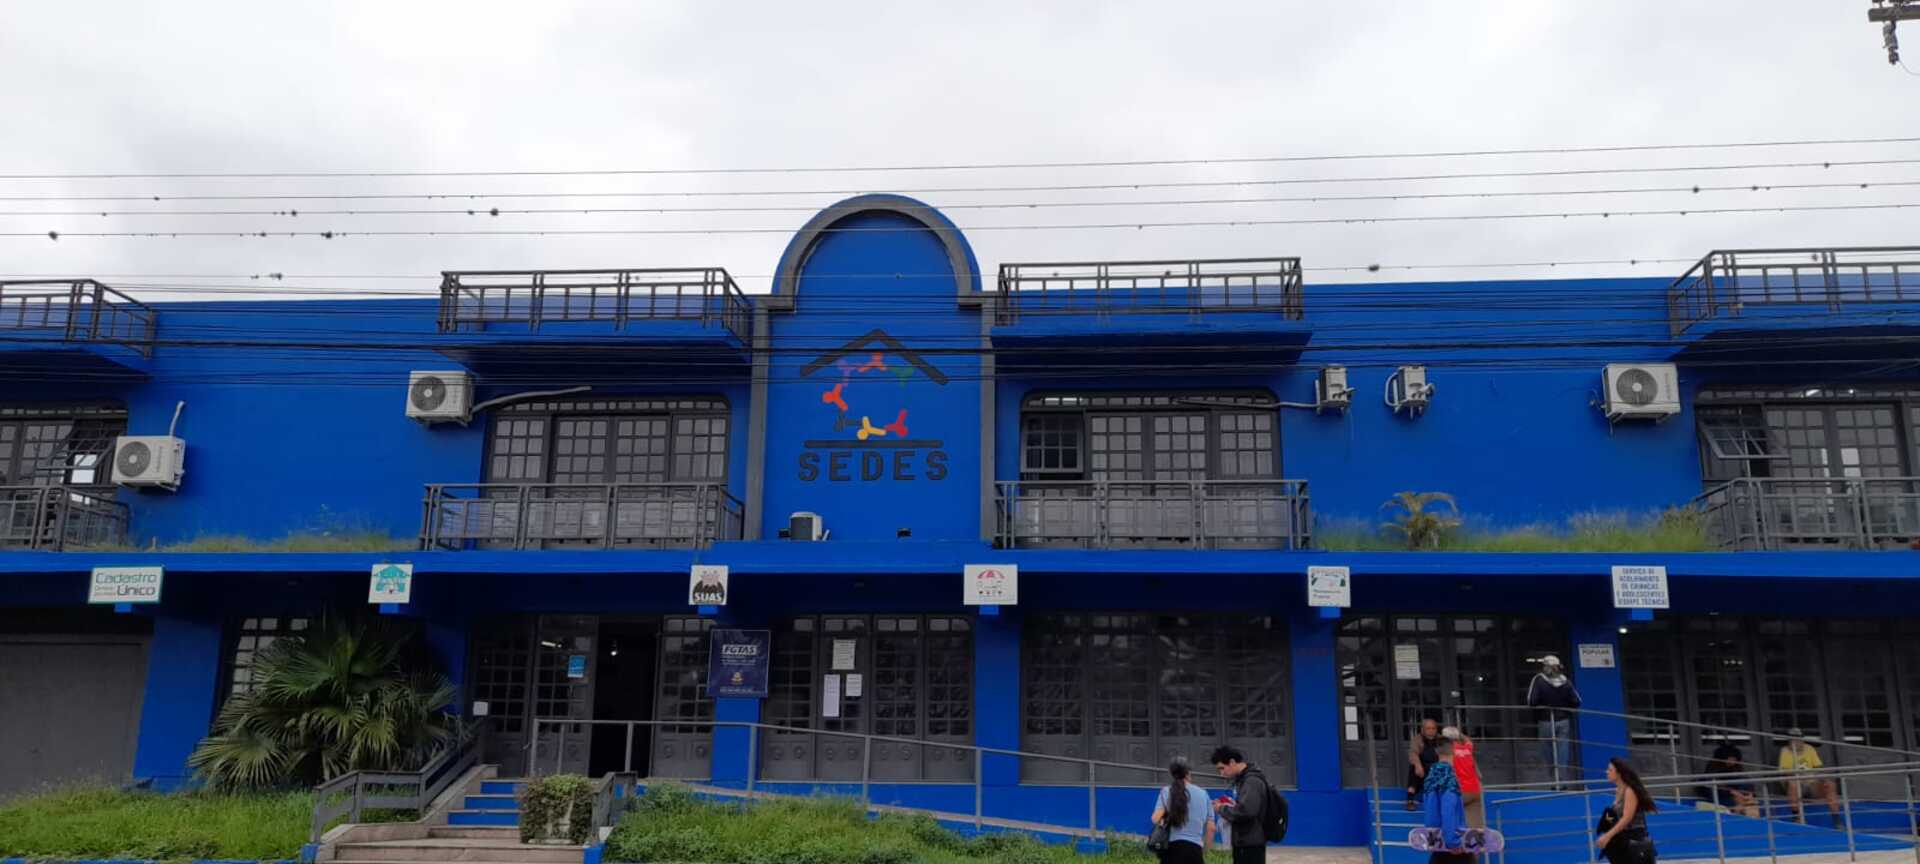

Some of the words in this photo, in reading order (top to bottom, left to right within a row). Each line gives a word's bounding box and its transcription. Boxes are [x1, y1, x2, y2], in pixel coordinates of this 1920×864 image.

[798, 450, 949, 482] SEDES
[96, 573, 157, 584] Cadastro
[117, 584, 156, 596] Único
[694, 592, 722, 601] SUAS
[724, 645, 756, 655] FGTAS
